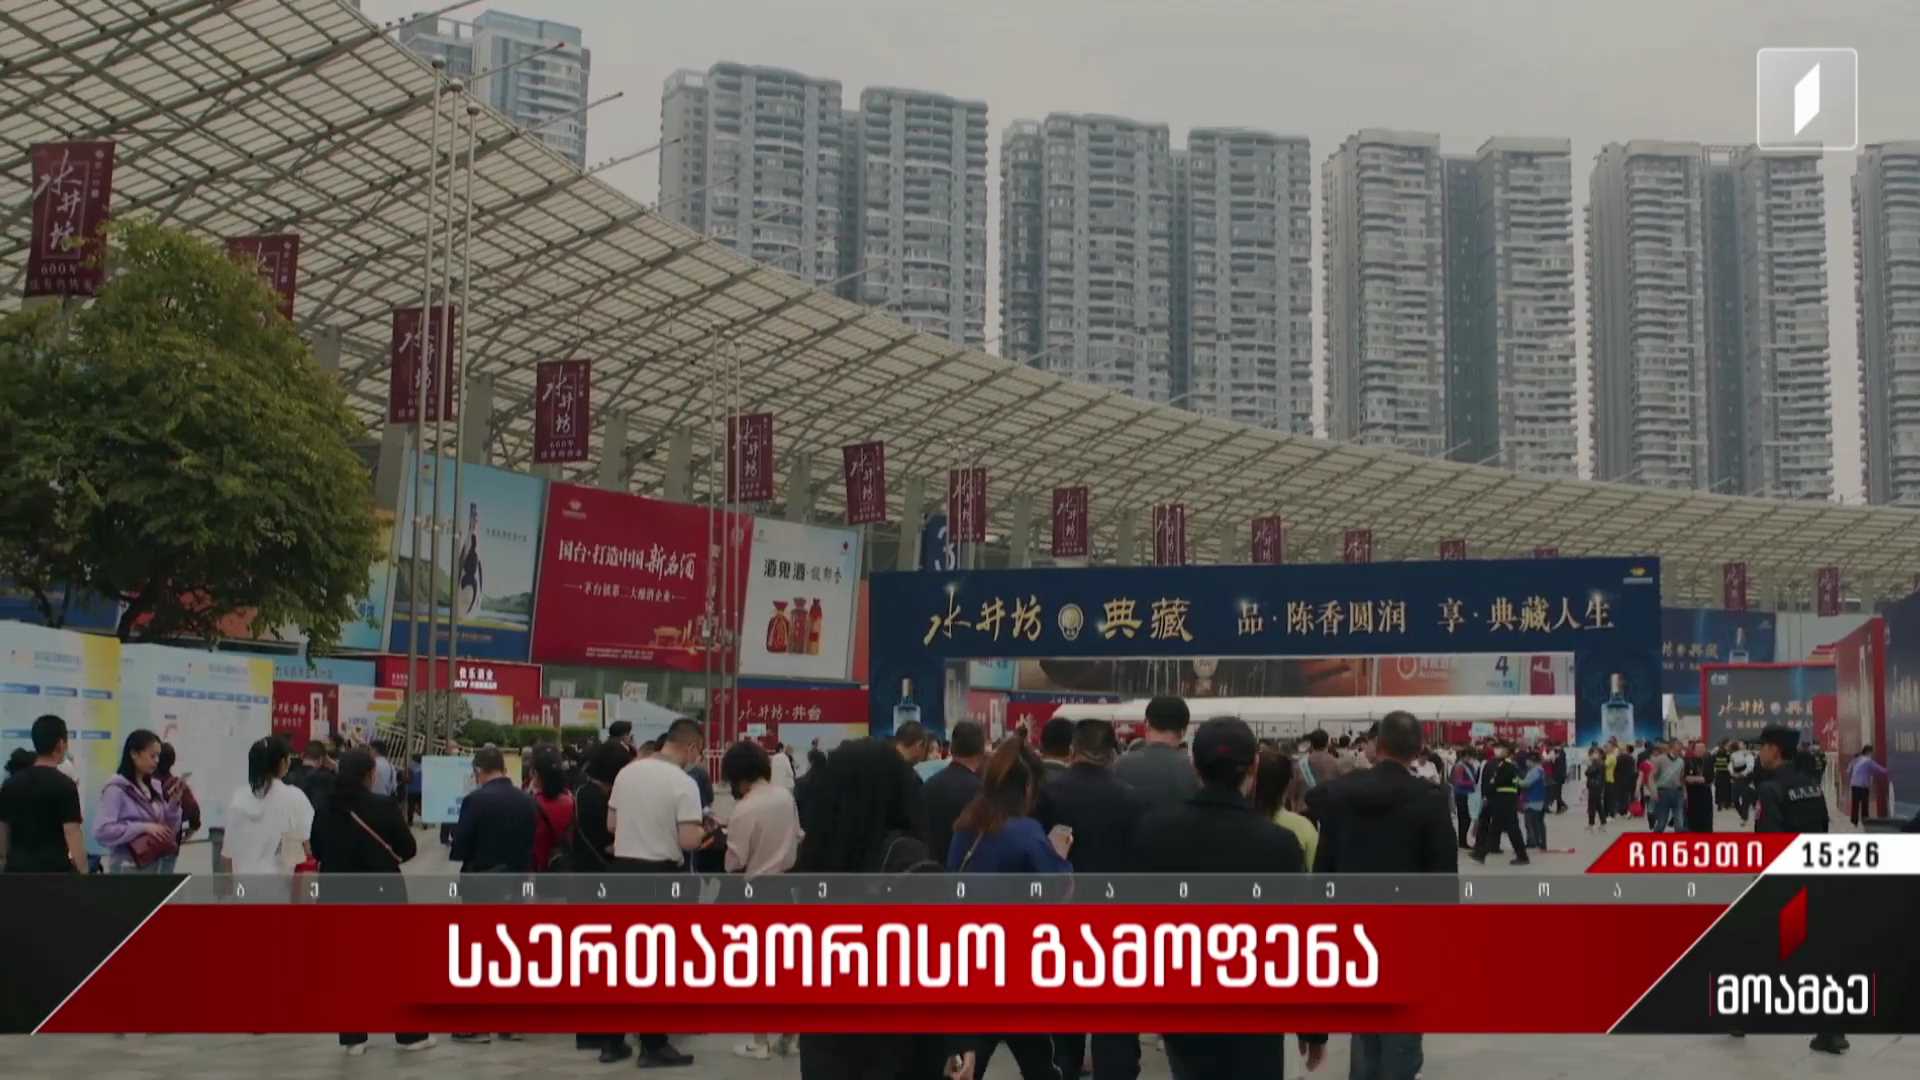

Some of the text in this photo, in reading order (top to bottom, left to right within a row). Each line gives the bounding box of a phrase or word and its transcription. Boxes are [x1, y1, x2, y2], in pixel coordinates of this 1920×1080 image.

[542, 364, 574, 434] 水井坊
[923, 586, 1043, 645] 水井坊
[1100, 597, 1194, 642] 典藏
[1437, 592, 1615, 635] 享·典藏人生
[1495, 656, 1509, 677] 4
